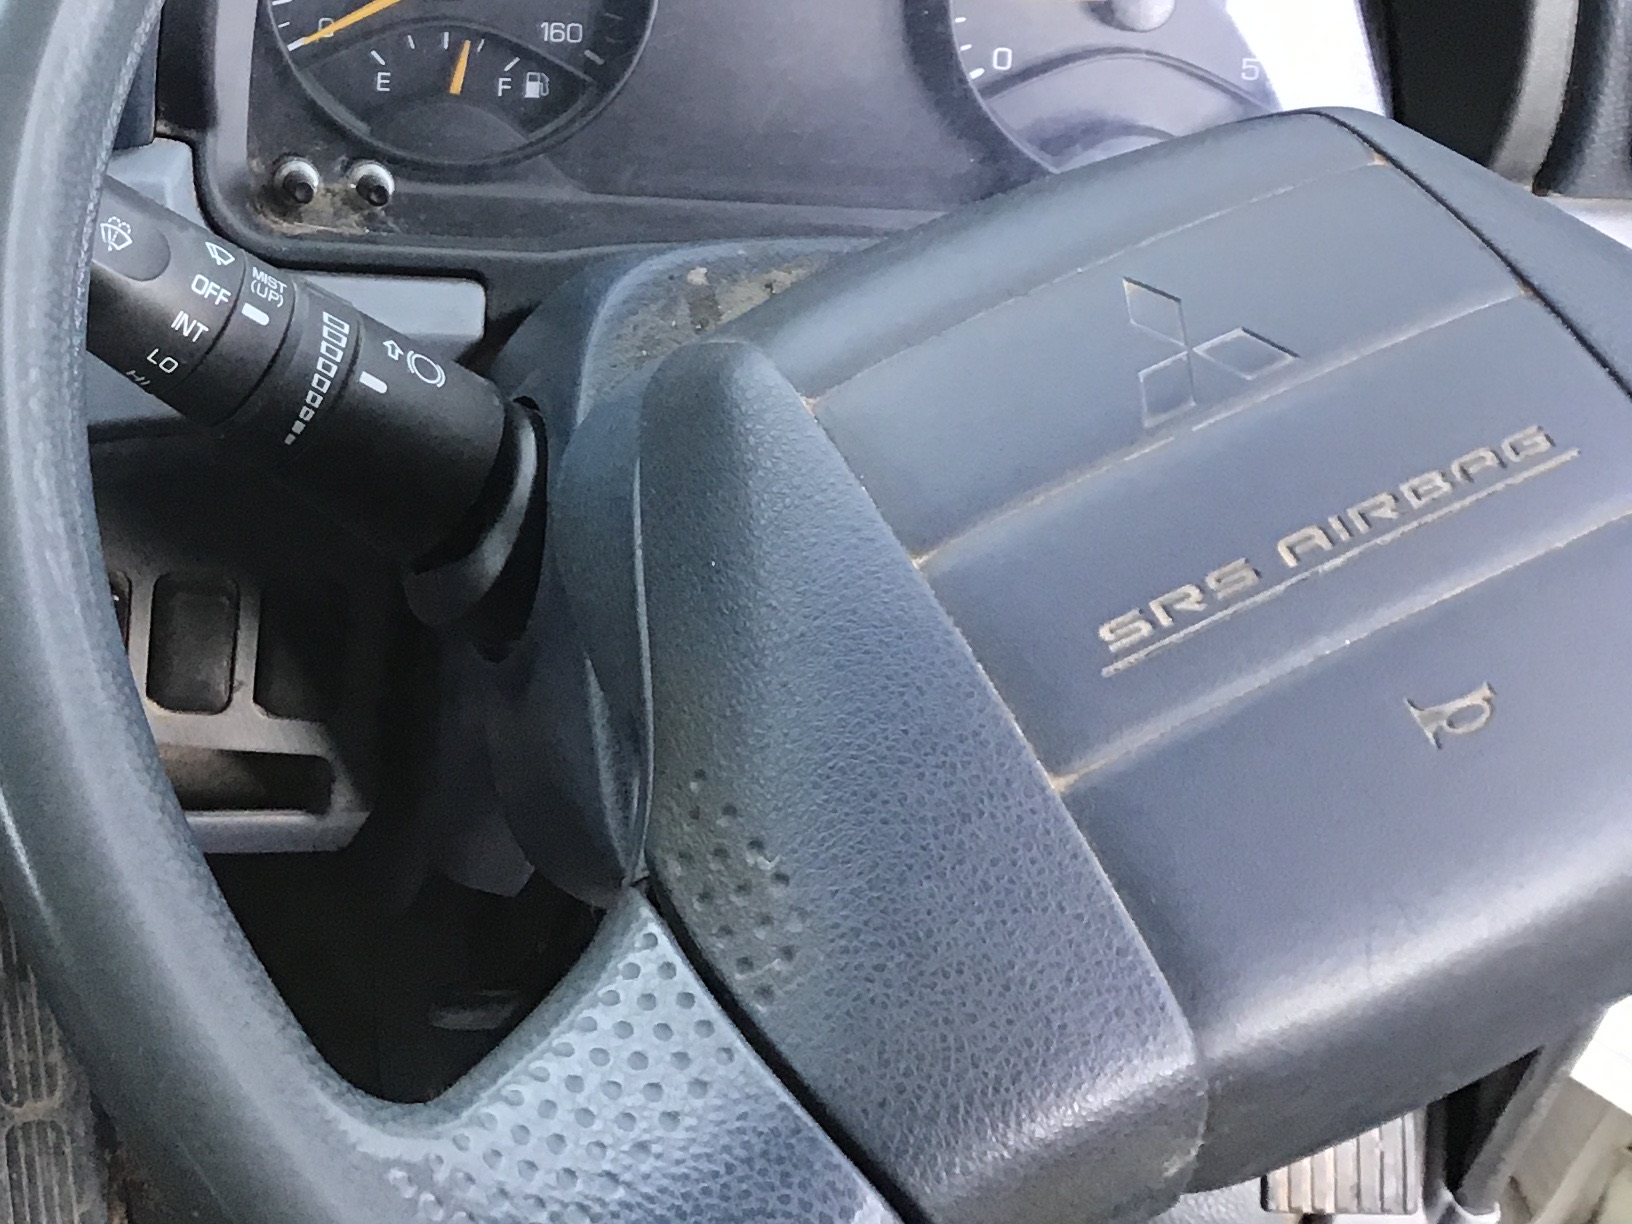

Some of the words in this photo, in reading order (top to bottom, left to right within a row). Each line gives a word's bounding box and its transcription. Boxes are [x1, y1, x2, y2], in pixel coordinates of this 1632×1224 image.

[540, 21, 584, 44] 160
[992, 46, 1013, 71] 0
[1240, 57, 1261, 82] 5
[376, 72, 392, 93] E
[497, 76, 513, 98] F
[190, 273, 232, 306] OFF
[249, 278, 285, 308] (UP)
[252, 265, 288, 295] MIST
[170, 310, 210, 343] INT
[146, 348, 180, 374] LO
[1098, 557, 1263, 653] SRS
[1276, 423, 1558, 569] AIRBAG
